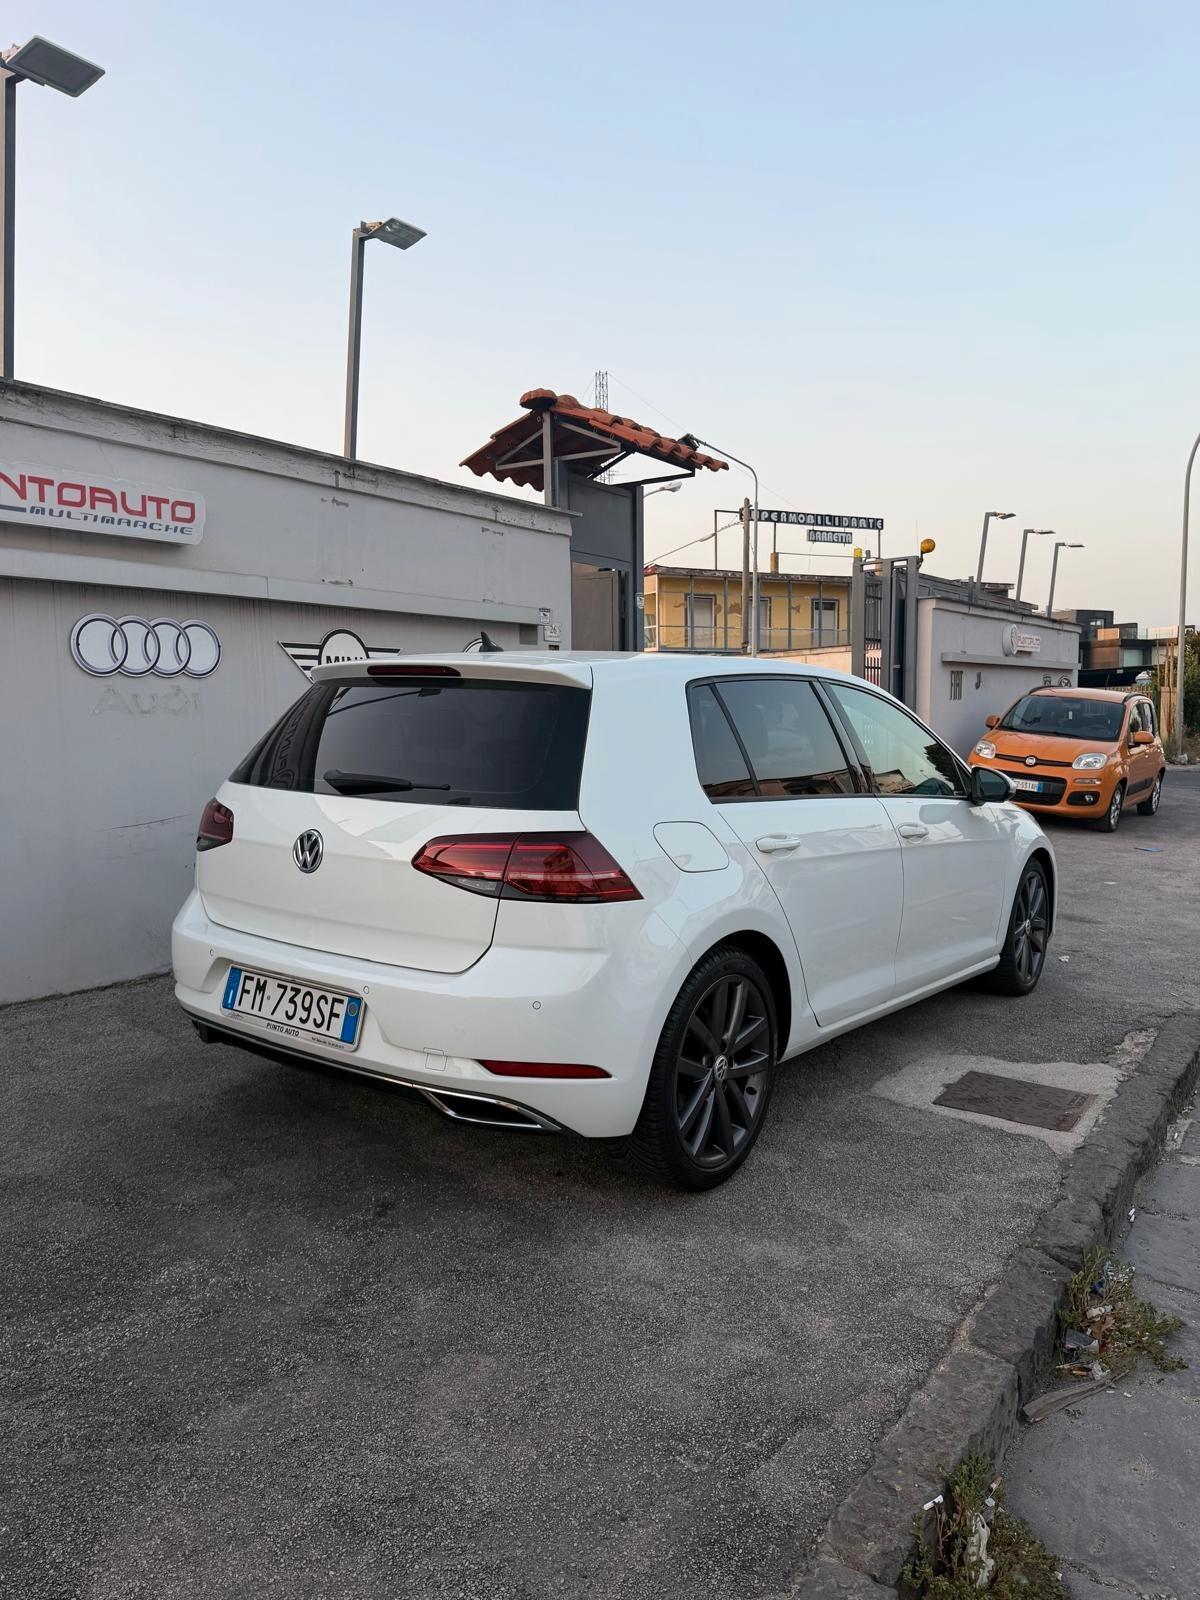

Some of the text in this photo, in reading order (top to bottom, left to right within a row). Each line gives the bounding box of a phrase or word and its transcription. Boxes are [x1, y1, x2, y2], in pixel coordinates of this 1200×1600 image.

[29, 505, 194, 535] MULTIMARCHE
[809, 531, 852, 543] BARRETTA
[238, 974, 345, 1032] FM 739SF
[266, 1022, 300, 1037] PUNTO AUTO
